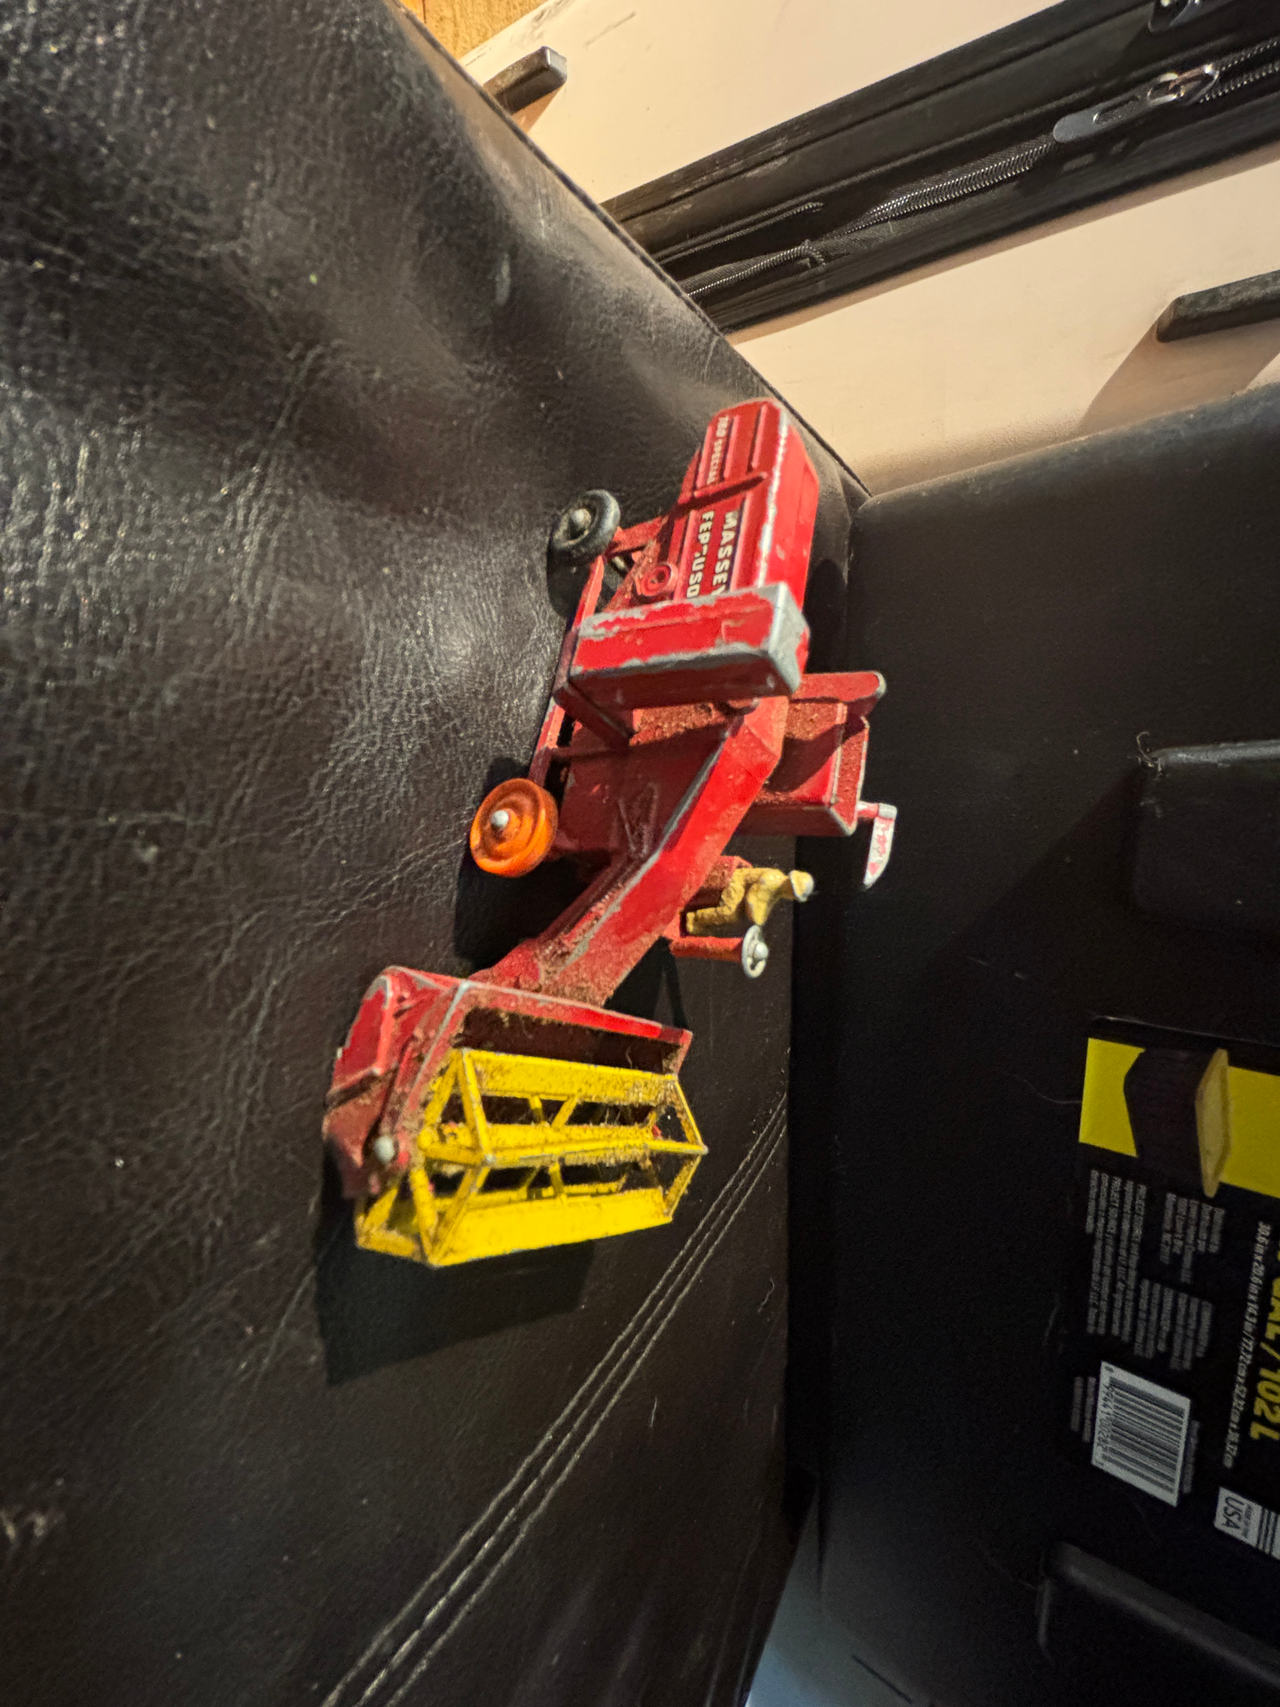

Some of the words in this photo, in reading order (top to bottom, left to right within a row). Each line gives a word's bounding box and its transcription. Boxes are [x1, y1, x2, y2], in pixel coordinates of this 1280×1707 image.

[686, 511, 715, 598] FERUSO
[1253, 1368, 1280, 1424] 102
[1250, 1421, 1280, 1440] L
[1222, 1496, 1245, 1530] USA
